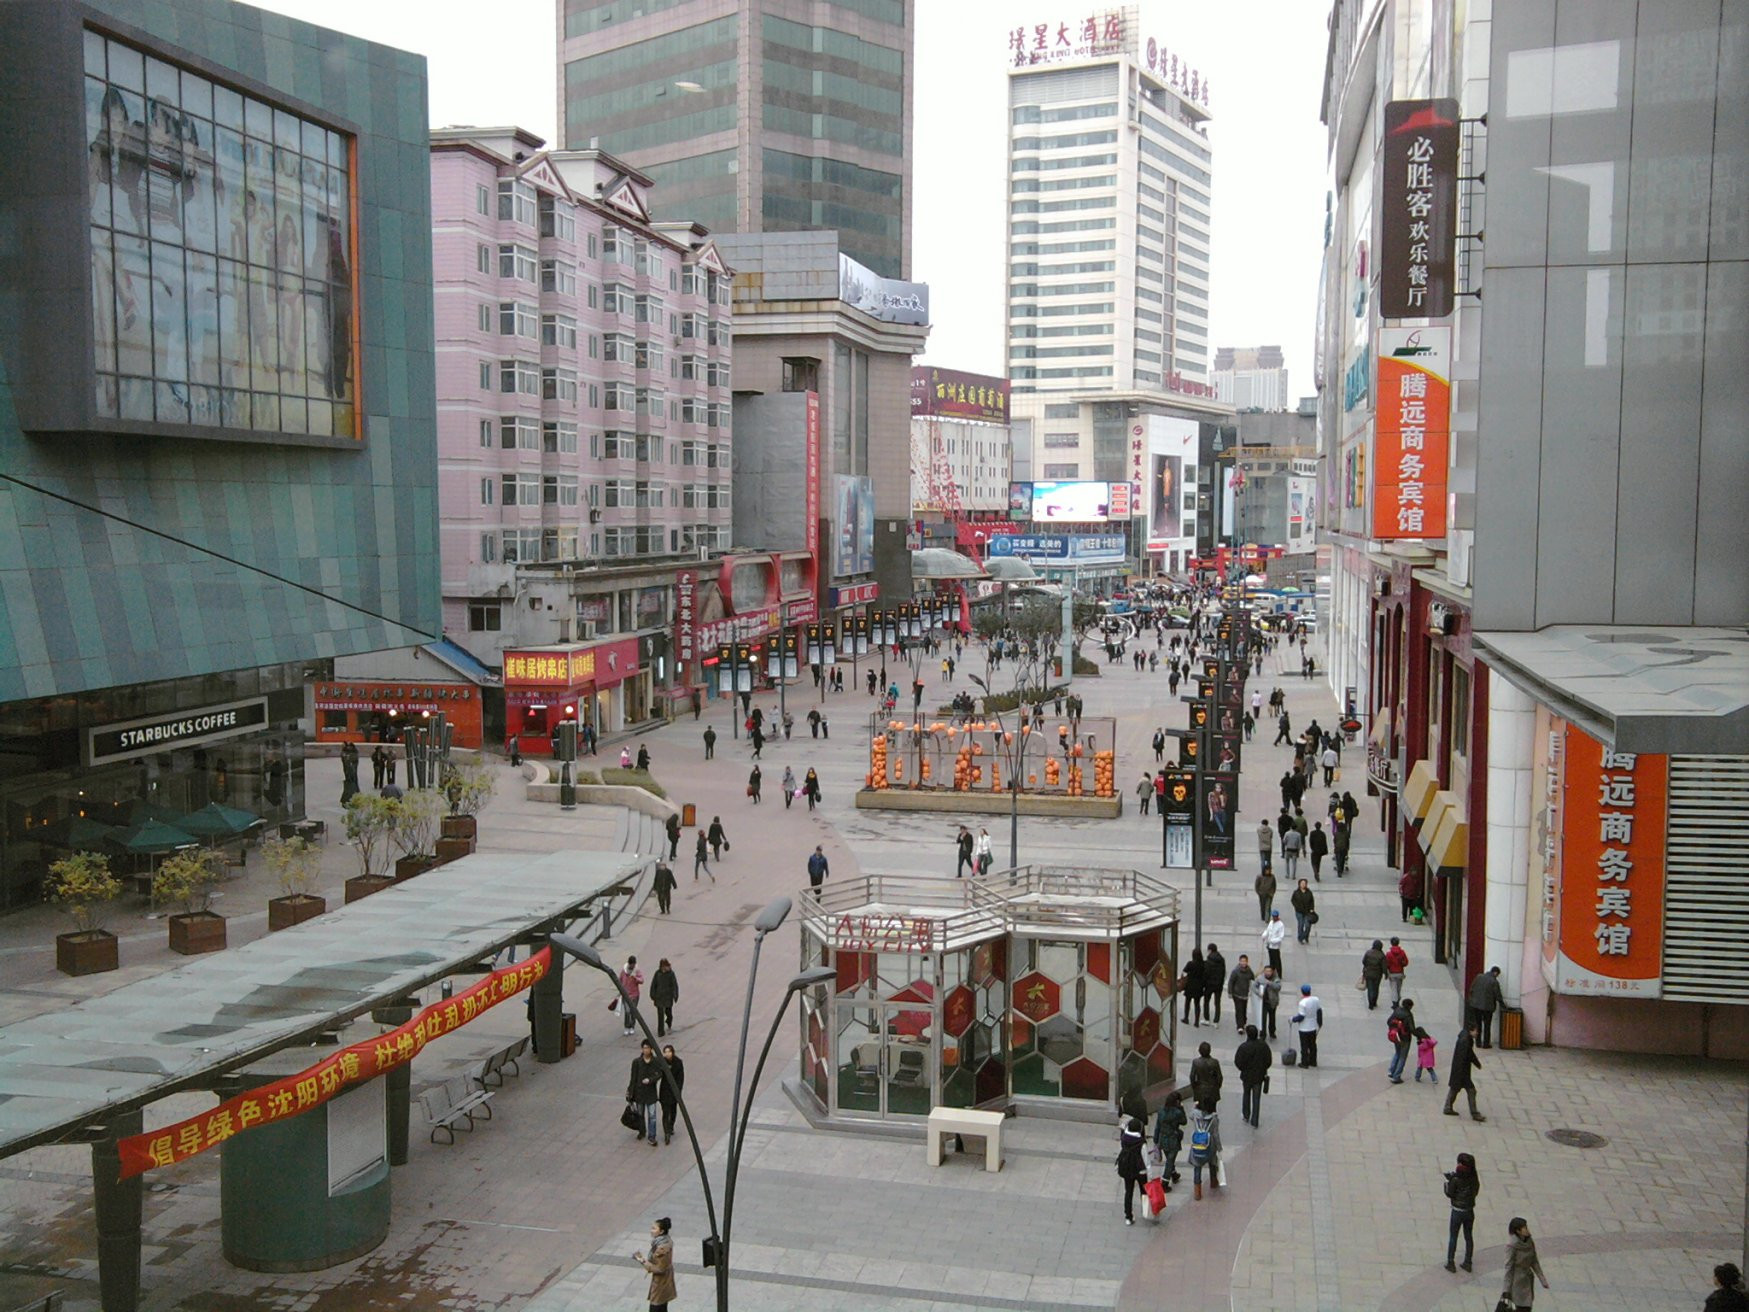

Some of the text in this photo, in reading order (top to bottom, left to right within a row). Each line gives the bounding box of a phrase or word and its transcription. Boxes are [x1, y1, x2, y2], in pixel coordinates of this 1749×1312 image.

[1406, 135, 1434, 308] 必胜客欢乐餐厅
[1397, 373, 1428, 533] 腾远商务宾馆
[120, 711, 237, 747] STARBUCKS COFFEE
[1592, 744, 1637, 956] 腾远商务宾馆
[149, 1053, 360, 1168] 倡导绿色沈阳环境
